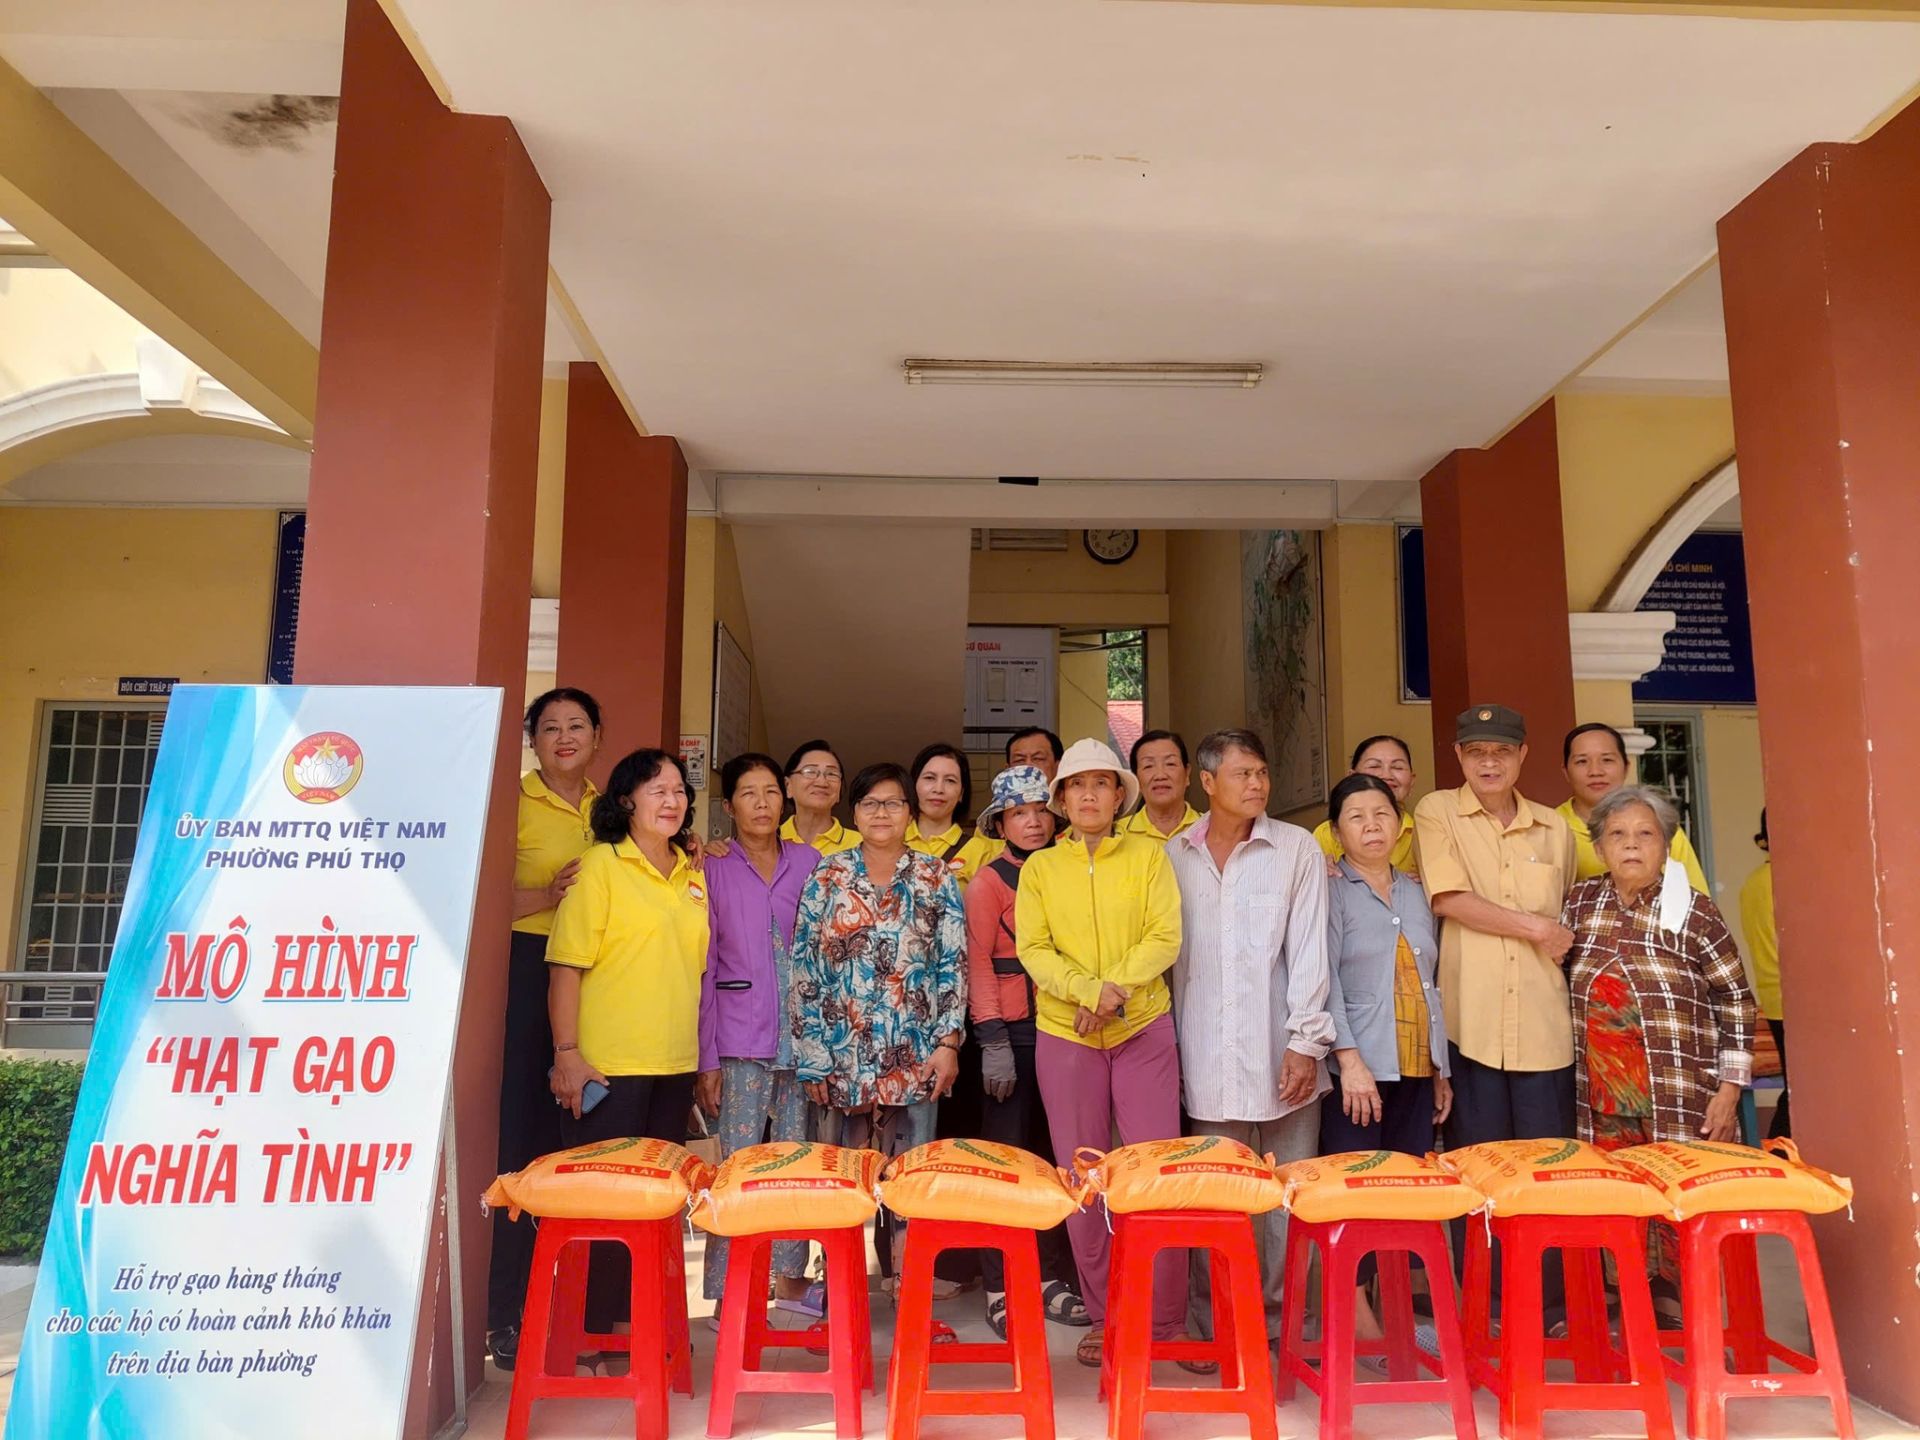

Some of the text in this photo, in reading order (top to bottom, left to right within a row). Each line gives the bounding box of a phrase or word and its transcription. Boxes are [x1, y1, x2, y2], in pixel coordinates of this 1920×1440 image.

[1692, 563, 1713, 573] MINH
[177, 813, 446, 842] ỦY BAN MTTQ VIỆT NAM
[205, 846, 406, 872] PHƯỜNG PHÚ THỌ
[155, 915, 418, 1001] MÔ HÌNH
[292, 1036, 396, 1106] GẠO
[79, 1128, 238, 1205] NGHĨA
[113, 1264, 342, 1296] Hỗ trợ gạo hàng tháng
[46, 1305, 392, 1336] cho các hộ có hoàn cảnh khó khăn
[107, 1348, 318, 1379] trên địa bàn phường
